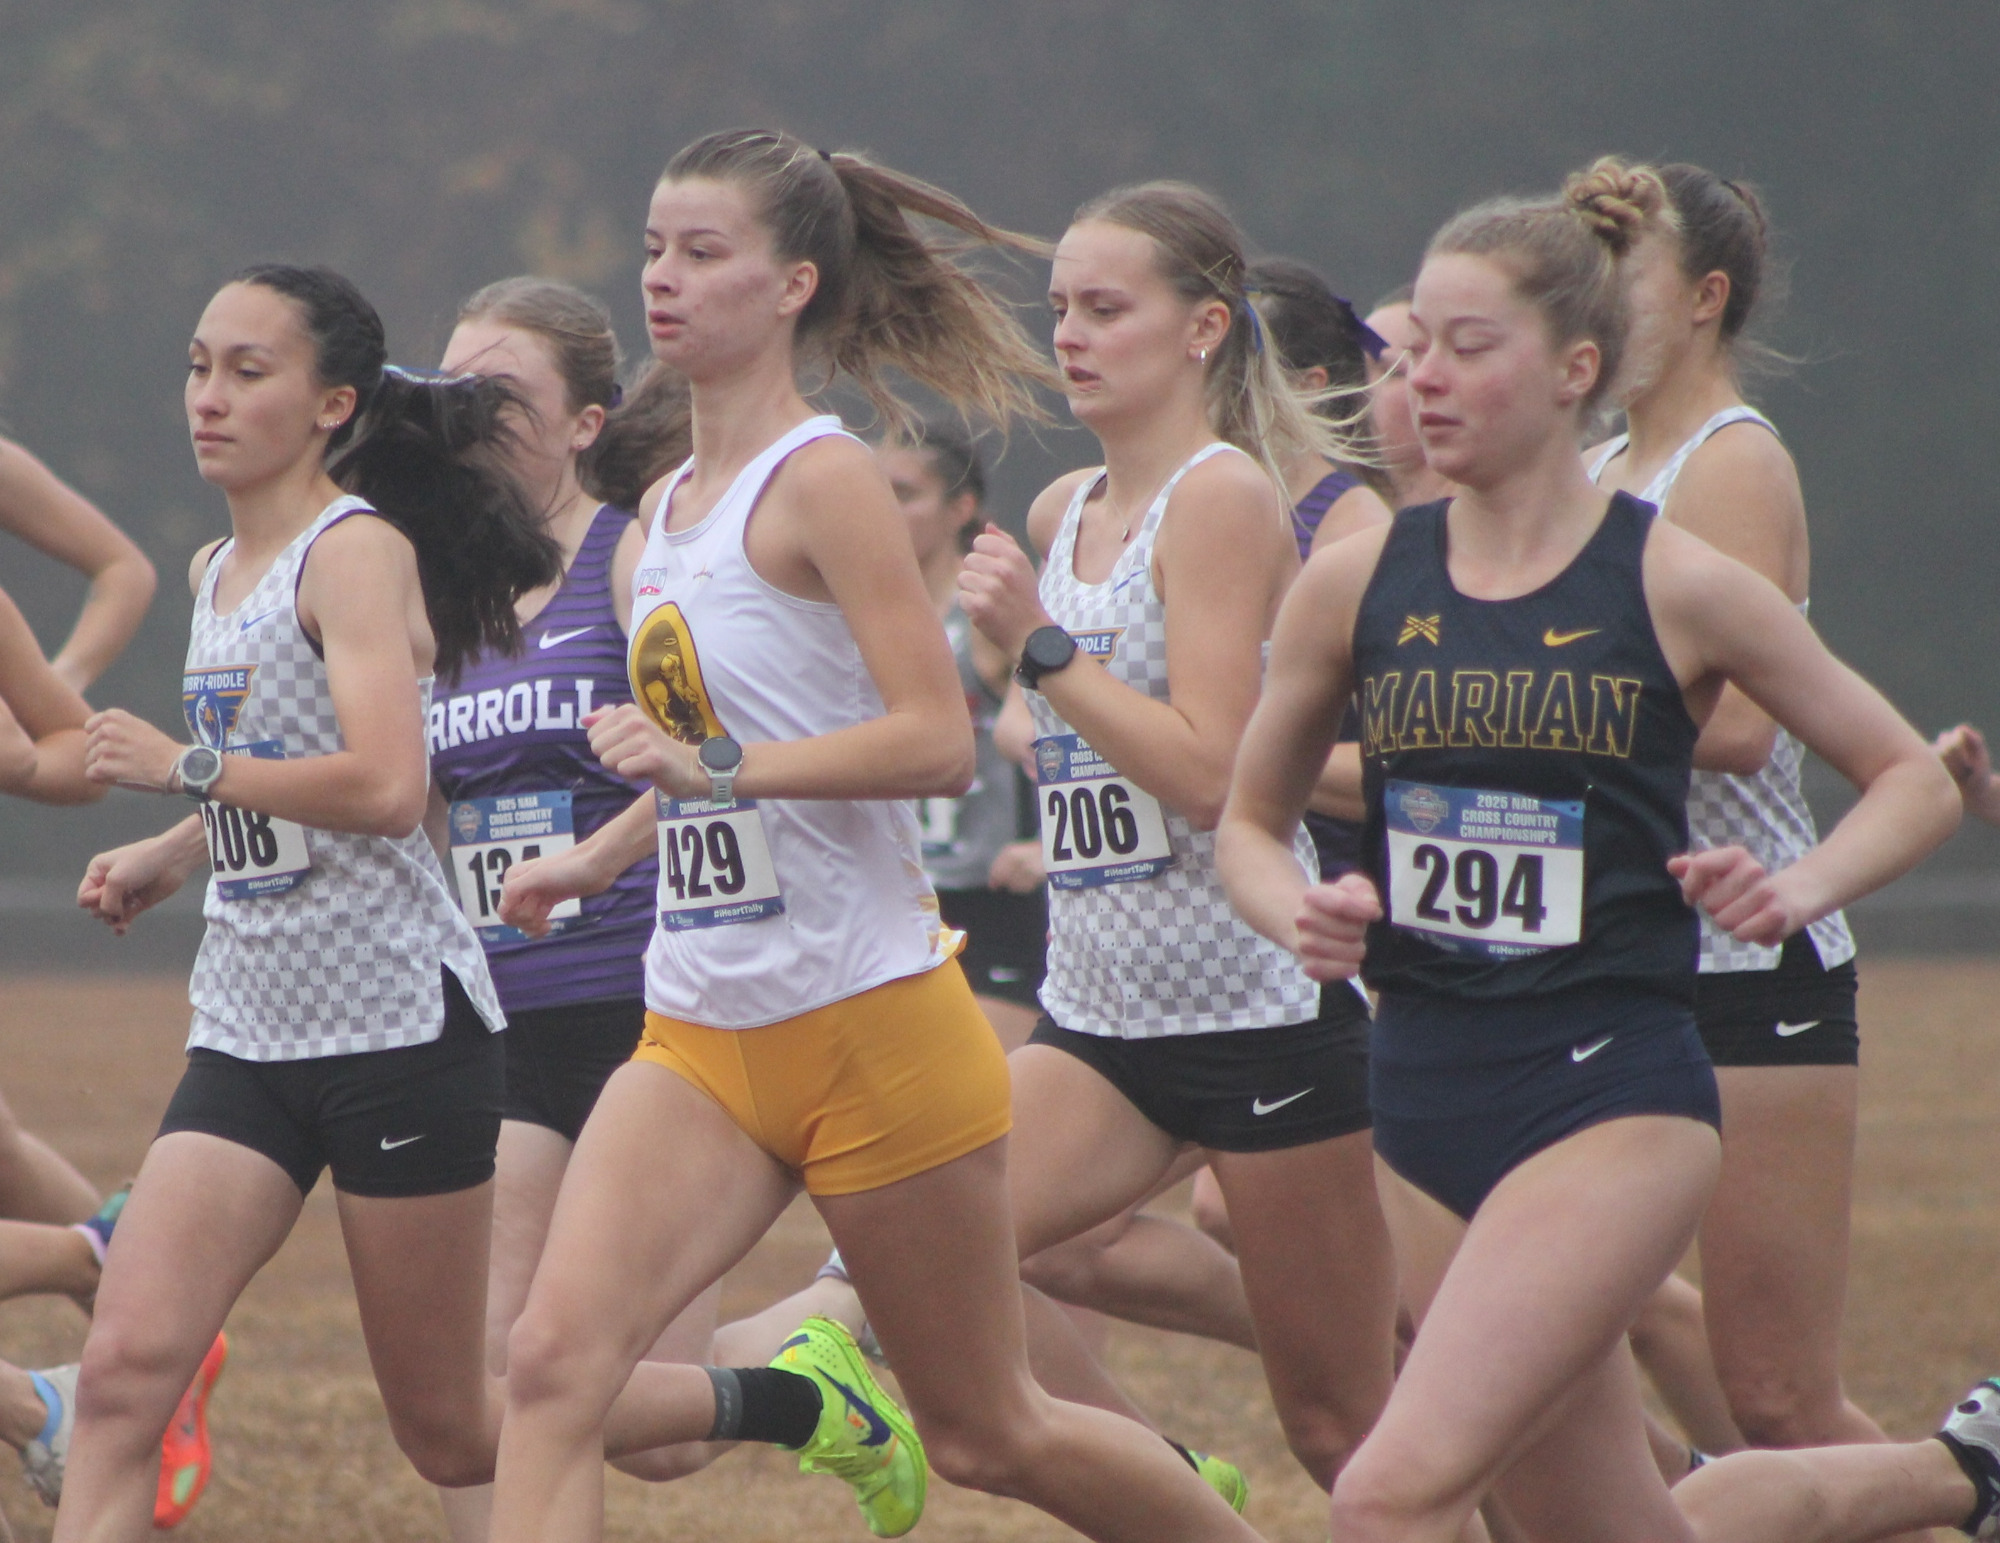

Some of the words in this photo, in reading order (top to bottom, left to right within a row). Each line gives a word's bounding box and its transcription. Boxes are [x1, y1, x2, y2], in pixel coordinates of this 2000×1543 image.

[1364, 671, 1642, 758] MARIAN
[1070, 750, 1093, 765] CROSS
[1477, 794, 1508, 809] 2025
[1511, 798, 1540, 811] NAIA
[489, 812, 514, 827] CROSS
[514, 808, 553, 823] COUNTRY
[1048, 784, 1139, 862] 206
[1461, 809, 1501, 824] CROSS
[1504, 812, 1559, 828] COUNTRY
[205, 803, 279, 872] 208
[489, 821, 553, 839] CHAMPIONSHIPS
[1459, 824, 1557, 844] CHAMPIONSHIPS
[667, 821, 746, 900] 429
[1104, 863, 1155, 878] #iHeartTally
[467, 844, 541, 917] 13
[1413, 843, 1547, 933] 294
[713, 903, 764, 918] #iHeartTally
